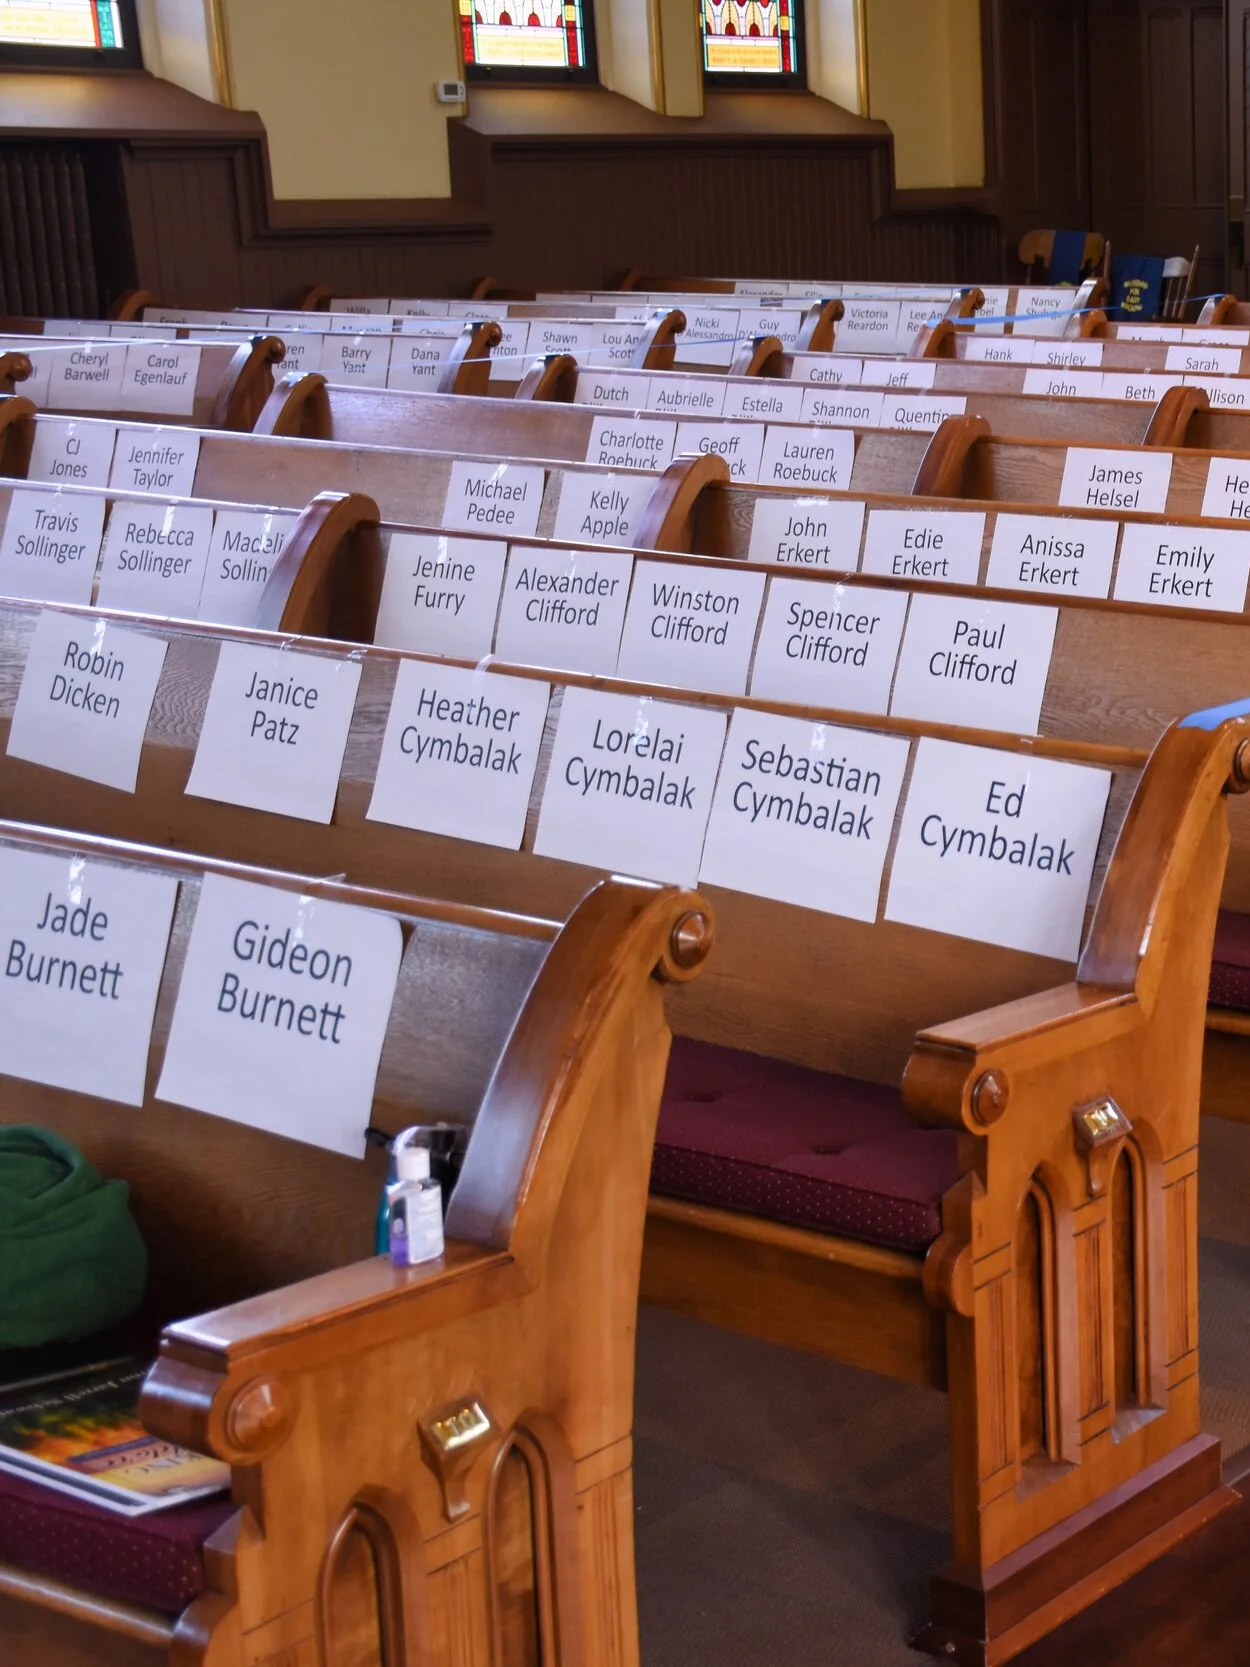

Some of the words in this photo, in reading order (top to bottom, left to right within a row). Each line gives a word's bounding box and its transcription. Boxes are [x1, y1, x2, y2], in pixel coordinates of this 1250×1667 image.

[851, 308, 888, 319] Victoria
[1031, 297, 1061, 308] Nancy
[695, 317, 720, 329] Nicki
[759, 319, 780, 331] Guy
[909, 310, 927, 320] Lee
[543, 331, 578, 344] Shawn
[847, 321, 888, 332] Reardon
[602, 333, 623, 345] Lou
[70, 352, 109, 366] Cheryl
[147, 355, 179, 369] Carol
[341, 346, 372, 360] Barry
[411, 348, 440, 361] Dana
[984, 348, 1013, 361] Hank
[1047, 352, 1086, 365] Shirley
[64, 368, 109, 381] Barwell
[343, 362, 366, 373] Yant
[413, 364, 436, 376] Yant
[810, 369, 842, 382] Cathy
[1185, 358, 1219, 371] Sarah
[134, 370, 188, 386] Egenlauf
[886, 374, 908, 386] Jeff
[1046, 382, 1076, 396] John
[594, 385, 629, 400] Dutch
[657, 391, 714, 407] Aubrielle
[1125, 385, 1156, 400] Beth
[742, 397, 783, 412] Estella
[812, 401, 869, 418] Shannon
[66, 438, 80, 455] CJ
[600, 430, 663, 450] Charlotte
[699, 438, 740, 454] Geoff
[784, 442, 834, 460] Lauren
[129, 446, 184, 465] Jennifer
[599, 452, 657, 469] Roebuck
[50, 459, 87, 478] Jones
[133, 468, 173, 490] Taylor
[773, 463, 837, 482] Roebuck
[1089, 464, 1143, 485] James
[464, 479, 527, 501] Michael
[1086, 488, 1139, 508] Helsel
[467, 503, 515, 524] Pedee
[590, 491, 629, 516] Kelly
[35, 510, 78, 532] Travis
[581, 515, 629, 539] Apple
[785, 517, 827, 537] John
[125, 523, 194, 547] Rebecca
[223, 531, 284, 554] Madeli
[904, 529, 943, 550] Edie
[15, 535, 86, 564] Sollinger
[776, 542, 830, 564] Erkert
[1020, 534, 1085, 559] Anissa
[118, 550, 191, 578] Sollinger
[412, 555, 475, 581] Jenine
[892, 555, 948, 577] Erkert
[1156, 545, 1214, 573] Emily
[220, 559, 270, 583] Sollin
[1018, 562, 1079, 587] Erkert
[515, 568, 619, 597] Alexander
[1149, 572, 1213, 598] Erkert
[414, 585, 465, 615] Furry
[653, 583, 739, 614] Winston
[526, 599, 599, 626] Clifford
[786, 602, 880, 635] Spencer
[651, 615, 729, 645] Clifford
[953, 620, 1006, 649] Paul
[63, 641, 125, 682] Robin
[786, 634, 868, 667] Clifford
[929, 651, 1017, 685] Clifford
[50, 675, 120, 718] Dicken
[246, 672, 318, 709] Janice
[417, 688, 520, 733] Heather
[250, 710, 300, 745] Patz
[400, 726, 522, 774] Cymbalak
[593, 719, 685, 764] Lorelai
[740, 738, 881, 797] Sebastian
[565, 756, 696, 809] Cymbalak
[733, 781, 875, 840] Cymbalak
[985, 781, 1026, 818] Ed
[920, 814, 1075, 875] Cymbalak
[37, 893, 108, 941] Jade
[233, 920, 353, 987] Gideon
[5, 939, 124, 1000] Burnett
[217, 972, 346, 1044] Burnett
